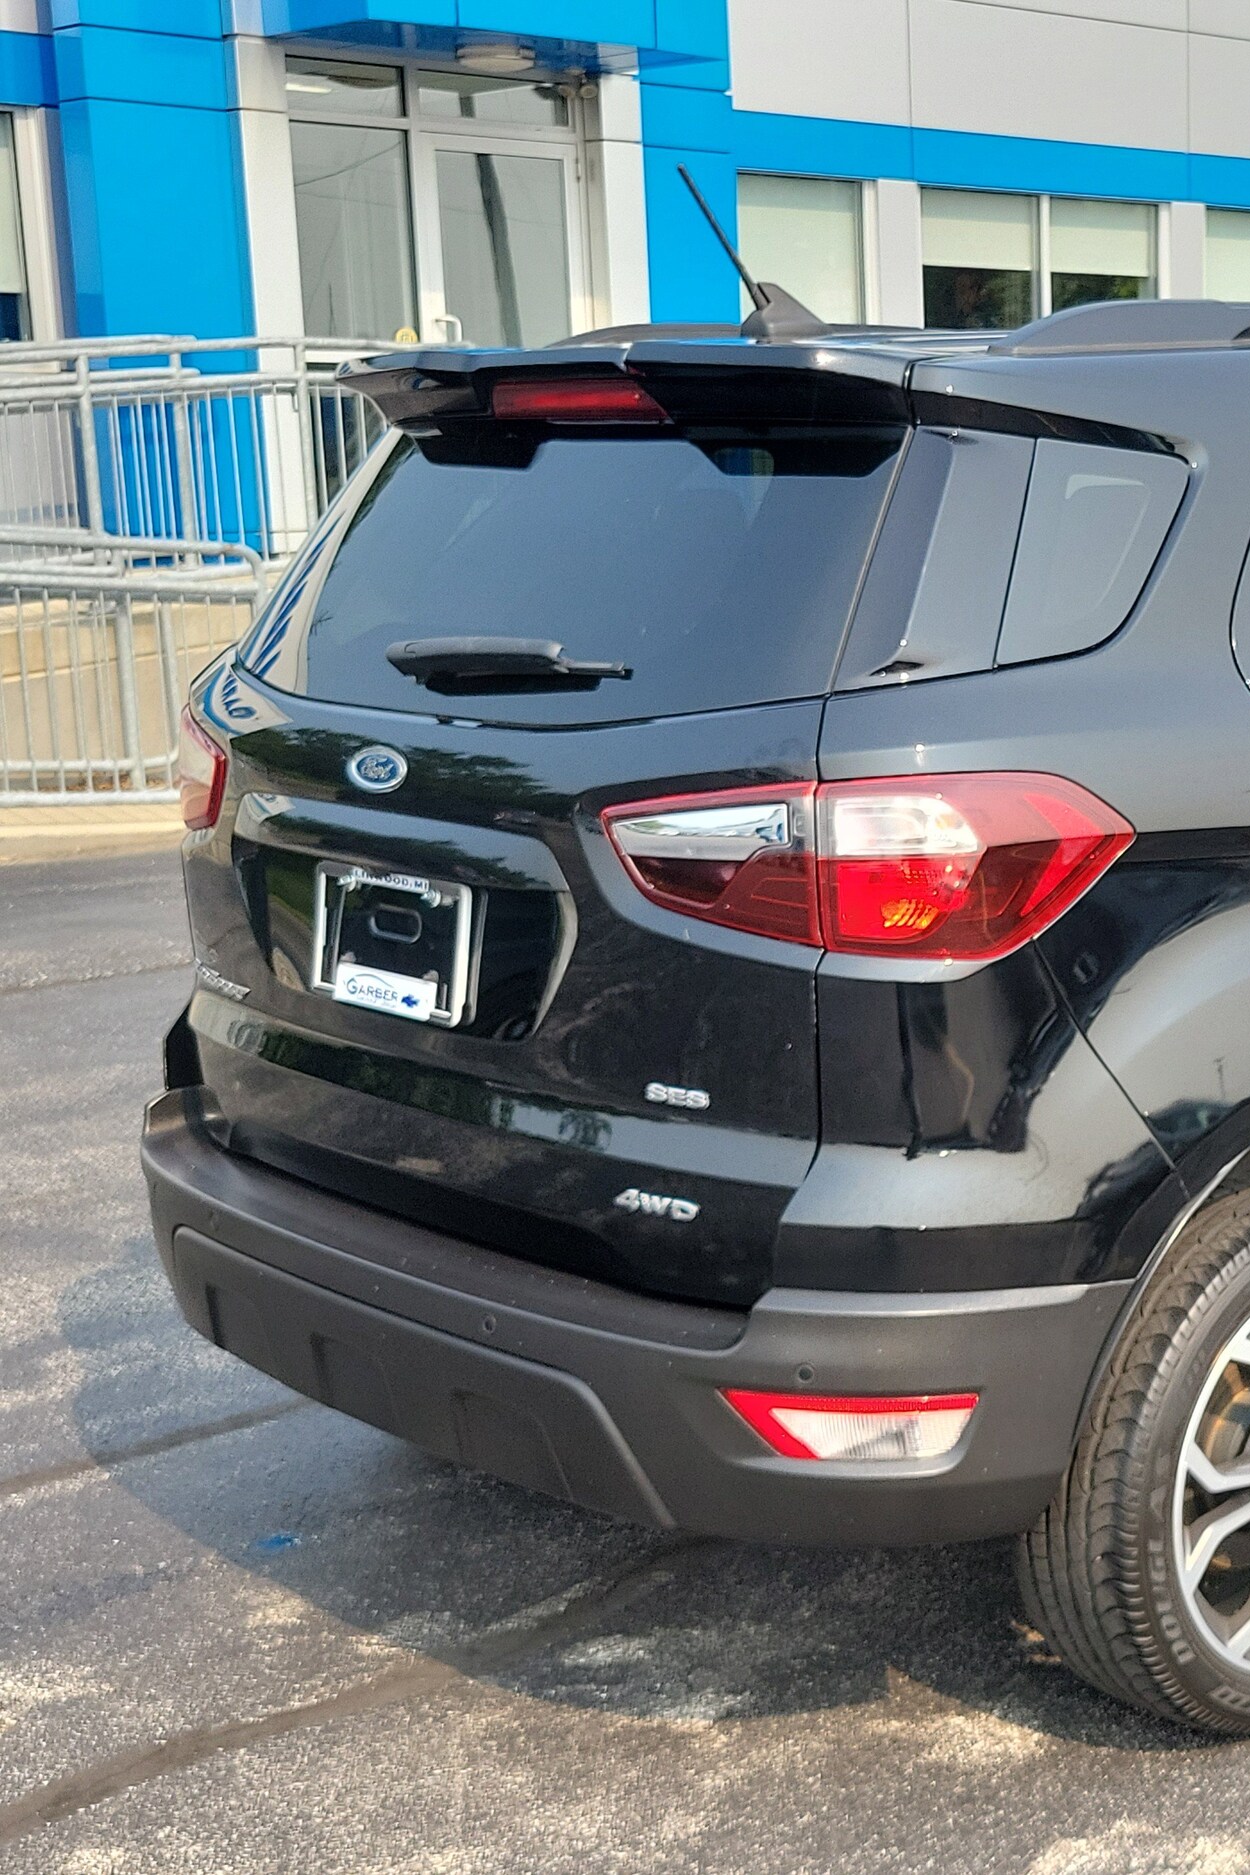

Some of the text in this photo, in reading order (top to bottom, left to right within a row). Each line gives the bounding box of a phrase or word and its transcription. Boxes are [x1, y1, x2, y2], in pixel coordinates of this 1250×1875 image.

[346, 977, 399, 1001] GARBER
[645, 1082, 710, 1110] SES
[614, 1188, 701, 1222] 4WD
